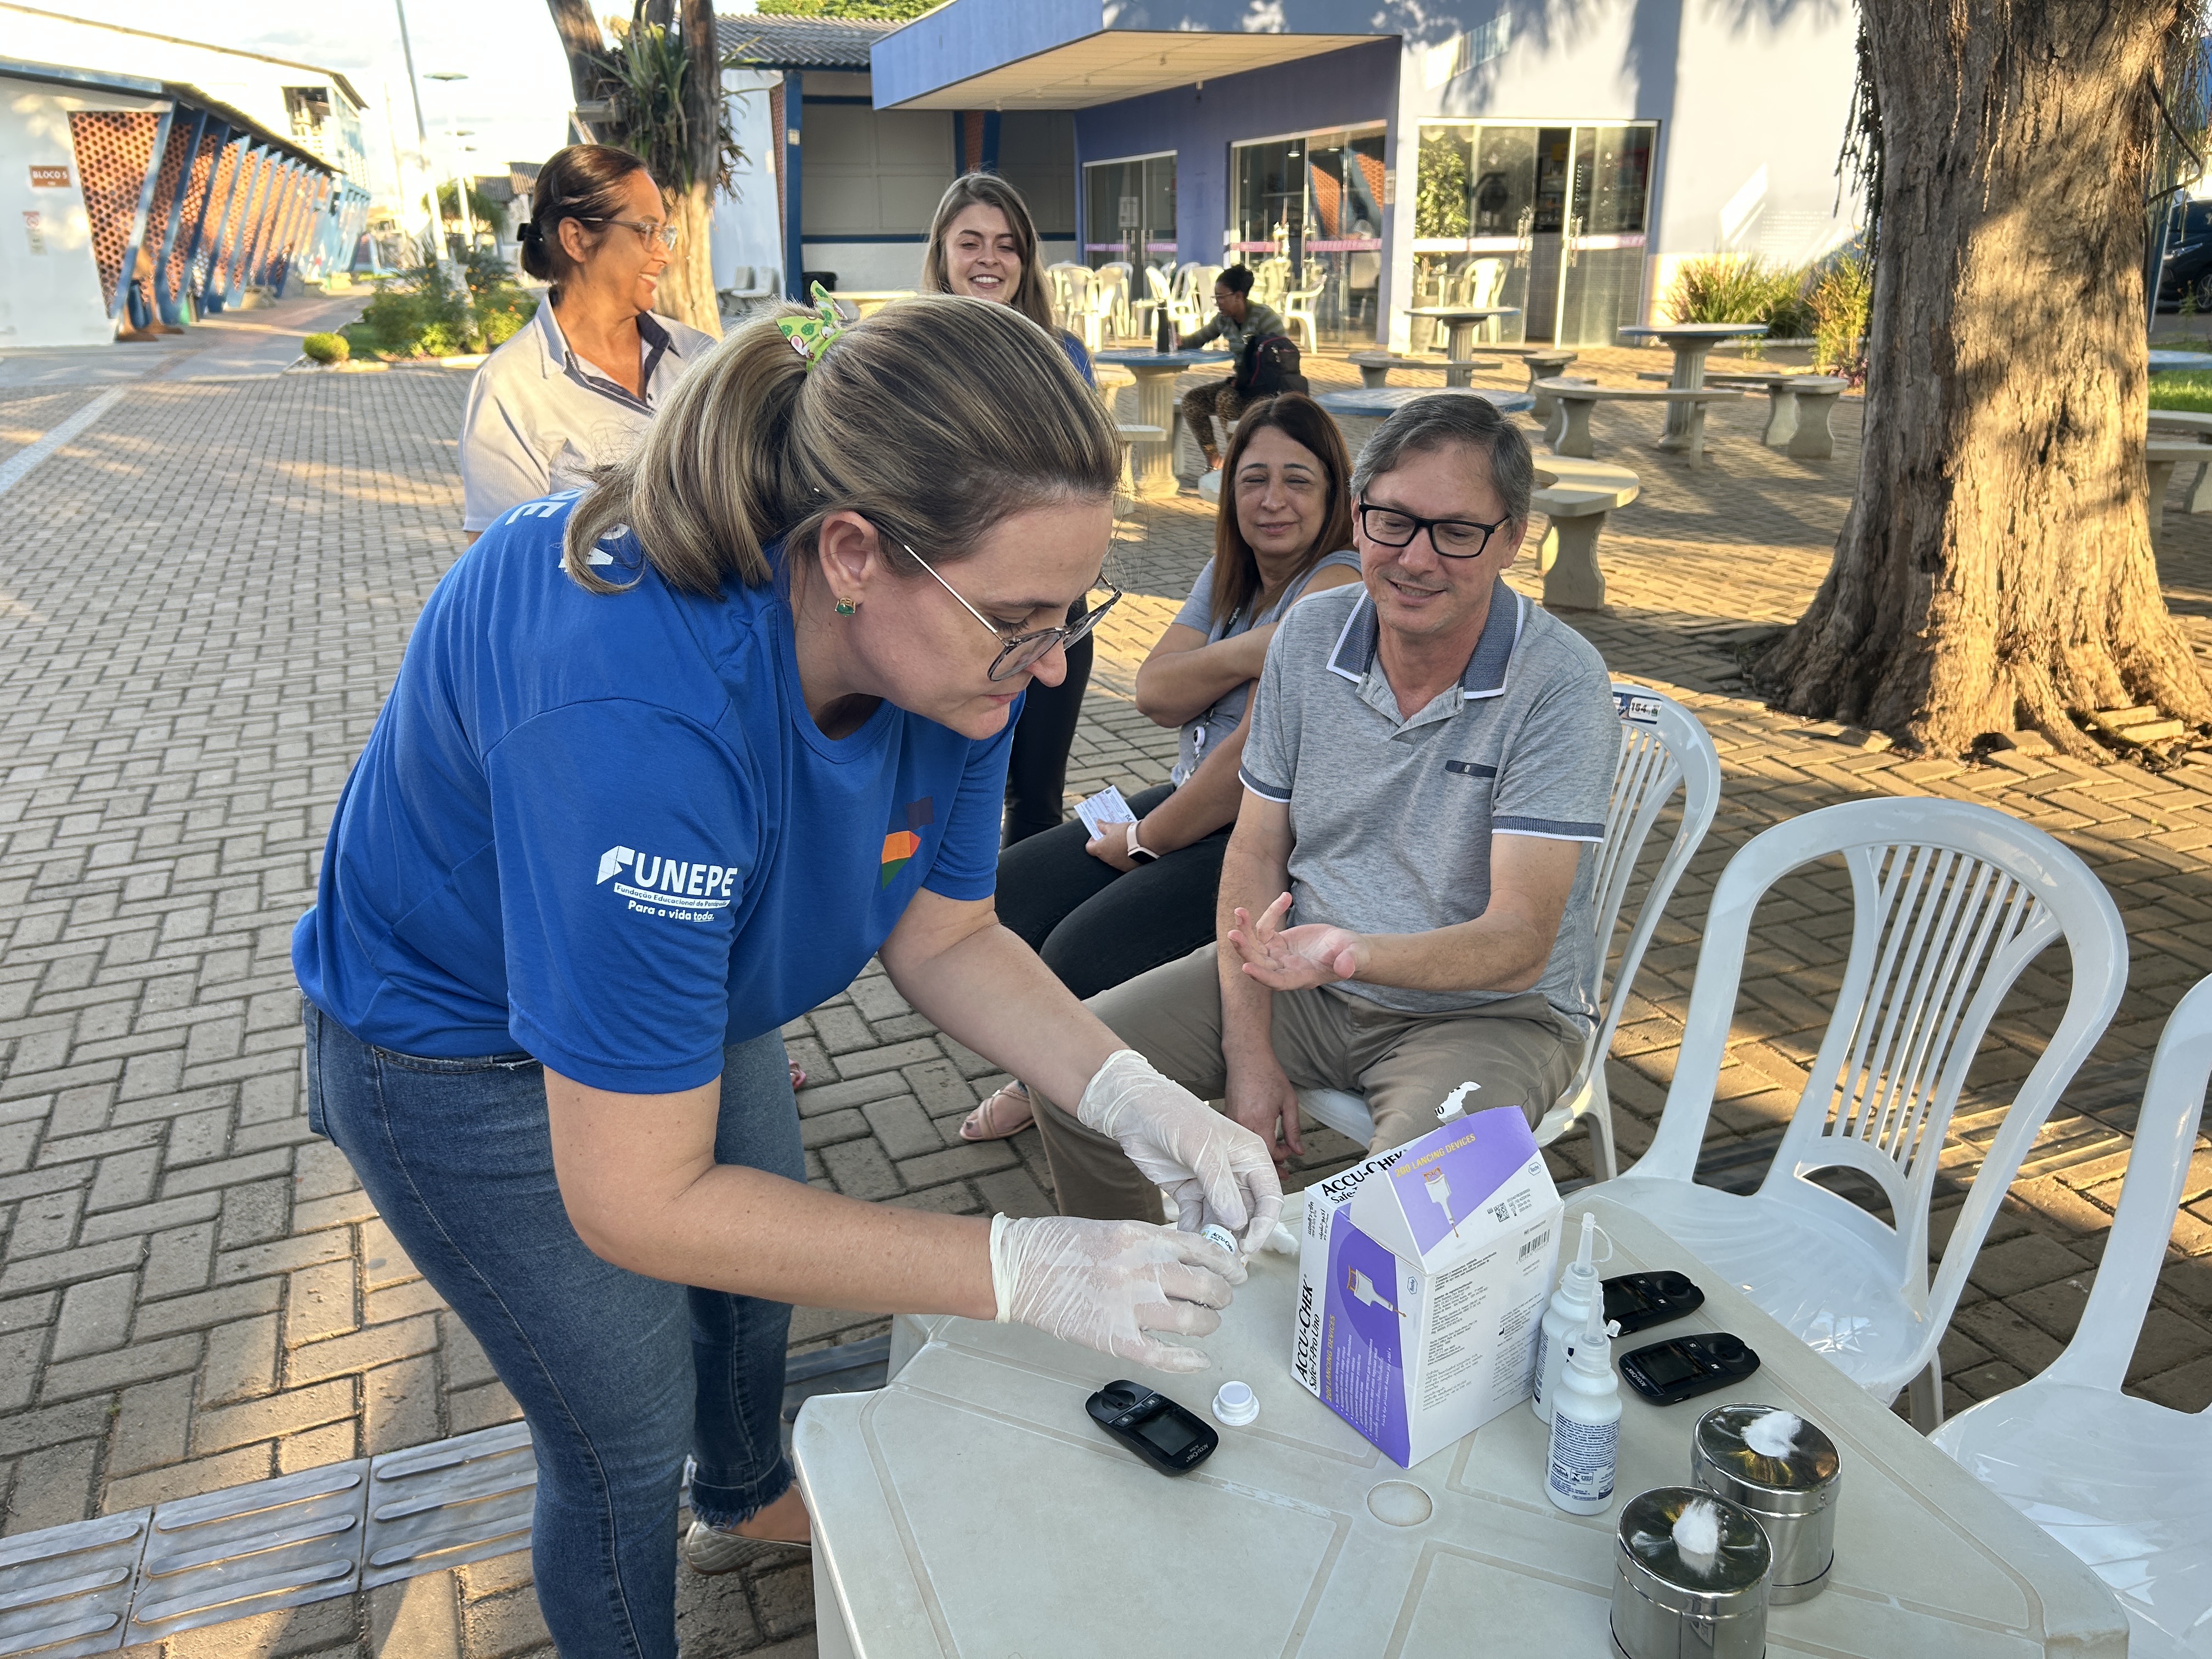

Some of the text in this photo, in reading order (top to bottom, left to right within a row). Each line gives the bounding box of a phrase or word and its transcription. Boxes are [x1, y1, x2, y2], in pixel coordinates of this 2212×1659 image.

[32, 171, 60, 179] BLOCO
[596, 845, 738, 897] FUNEPE
[616, 884, 652, 900] Fundação
[653, 894, 696, 907] Educacional
[628, 900, 715, 922] Para a vida toda.
[1394, 1133, 1476, 1178] 200 LANCING DEVICES
[1295, 1277, 1313, 1383] ACCU-CHEK
[1308, 1313, 1320, 1390] Safe-T-Pro Uno
[1627, 1368, 1647, 1387] ACCU-CHEK
[1186, 1442, 1209, 1462] ACCU-CHEK
[1552, 1463, 1569, 1479] Prolink
